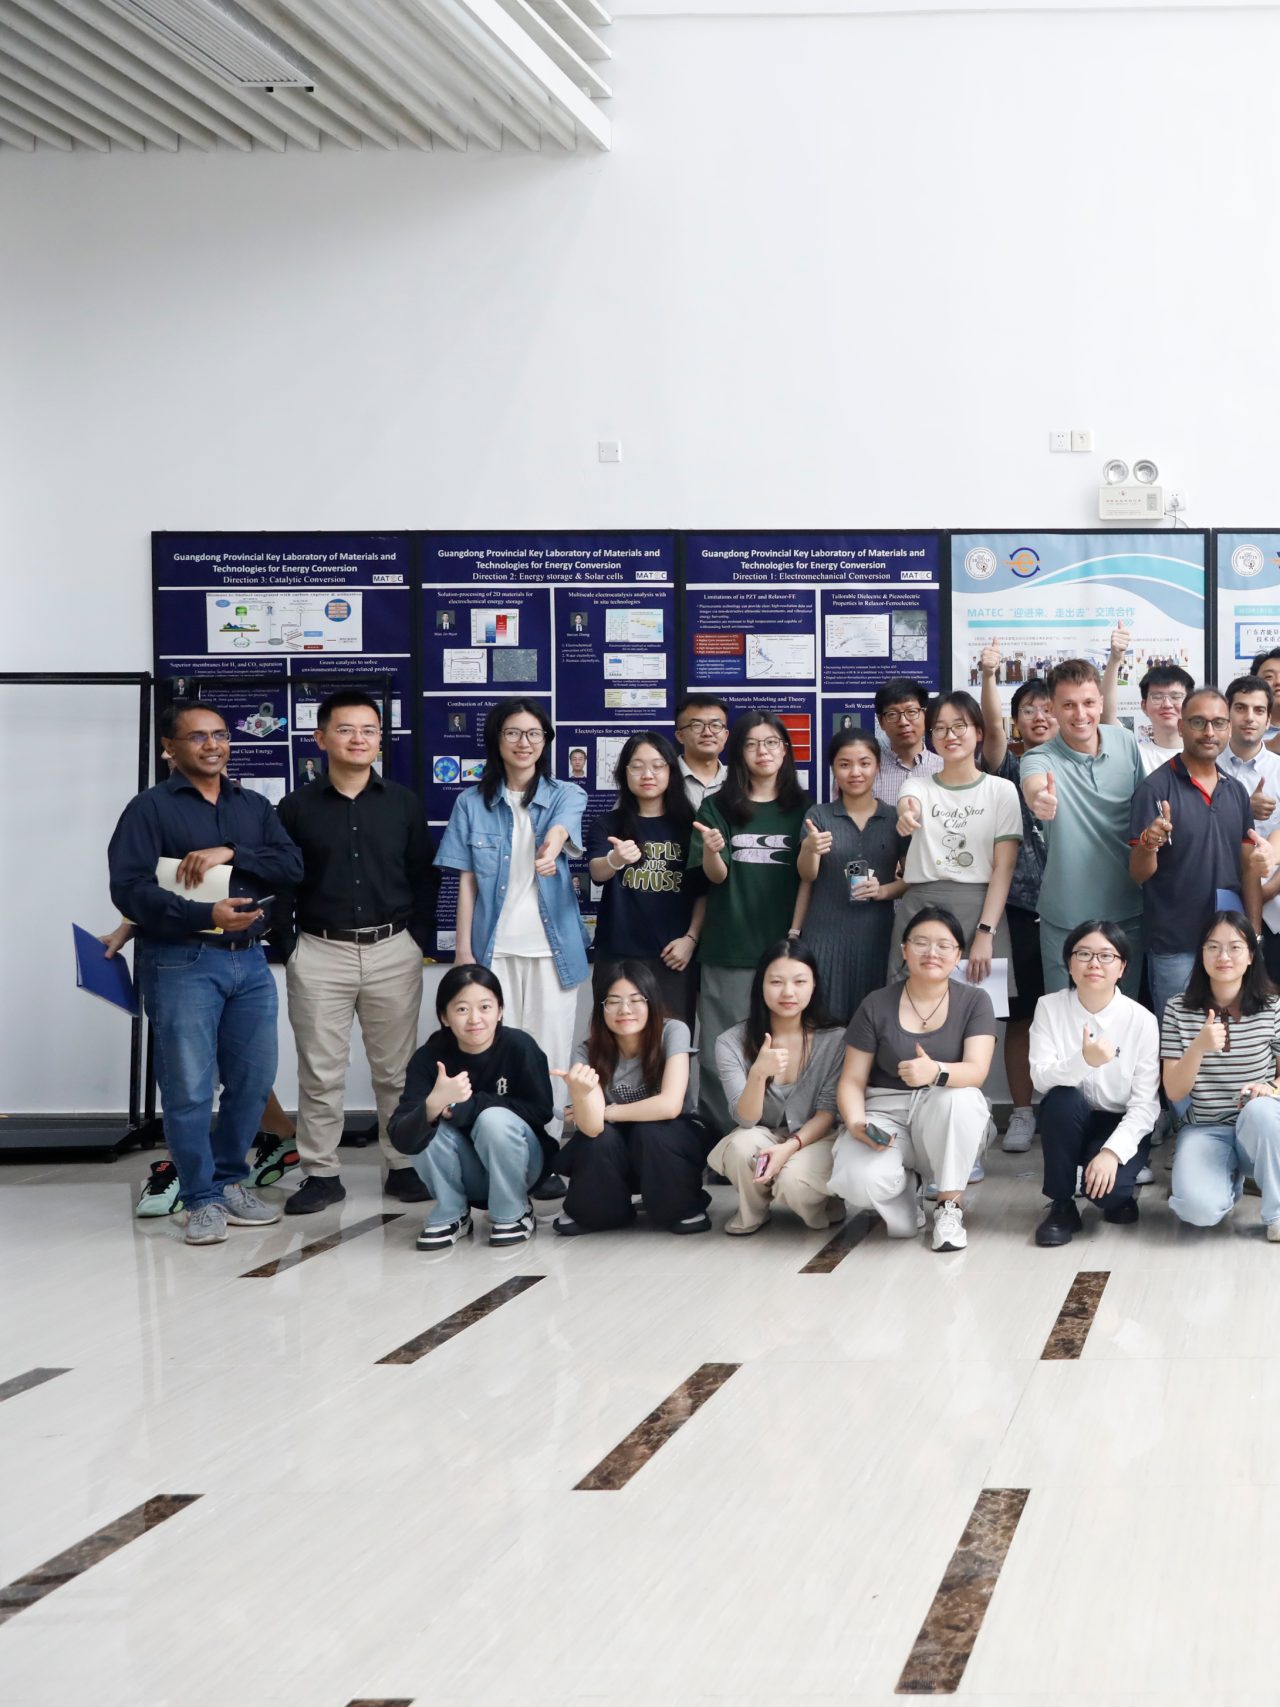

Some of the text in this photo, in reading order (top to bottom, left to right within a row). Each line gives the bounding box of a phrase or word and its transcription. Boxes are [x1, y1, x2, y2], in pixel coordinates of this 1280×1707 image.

[174, 552, 396, 562] Guangdong Provincial Key Laboratory of Materials and
[438, 548, 660, 559] Guangdong Provincial Key Laboratory of Materials and
[702, 548, 925, 559] Guangdong Provincial Key Laboratory of Materials and
[212, 564, 358, 574] Technologies for Energy Conversion
[476, 561, 621, 570] Technologies for Energy Conversion
[740, 561, 886, 570] Technologies for Energy Conversion
[269, 576, 302, 584] Catalytic
[520, 573, 544, 582] Energy
[967, 608, 1004, 617] MATEC
[932, 804, 984, 818] Good Shot
[944, 819, 967, 828] Club
[622, 867, 683, 892] AMUSE
